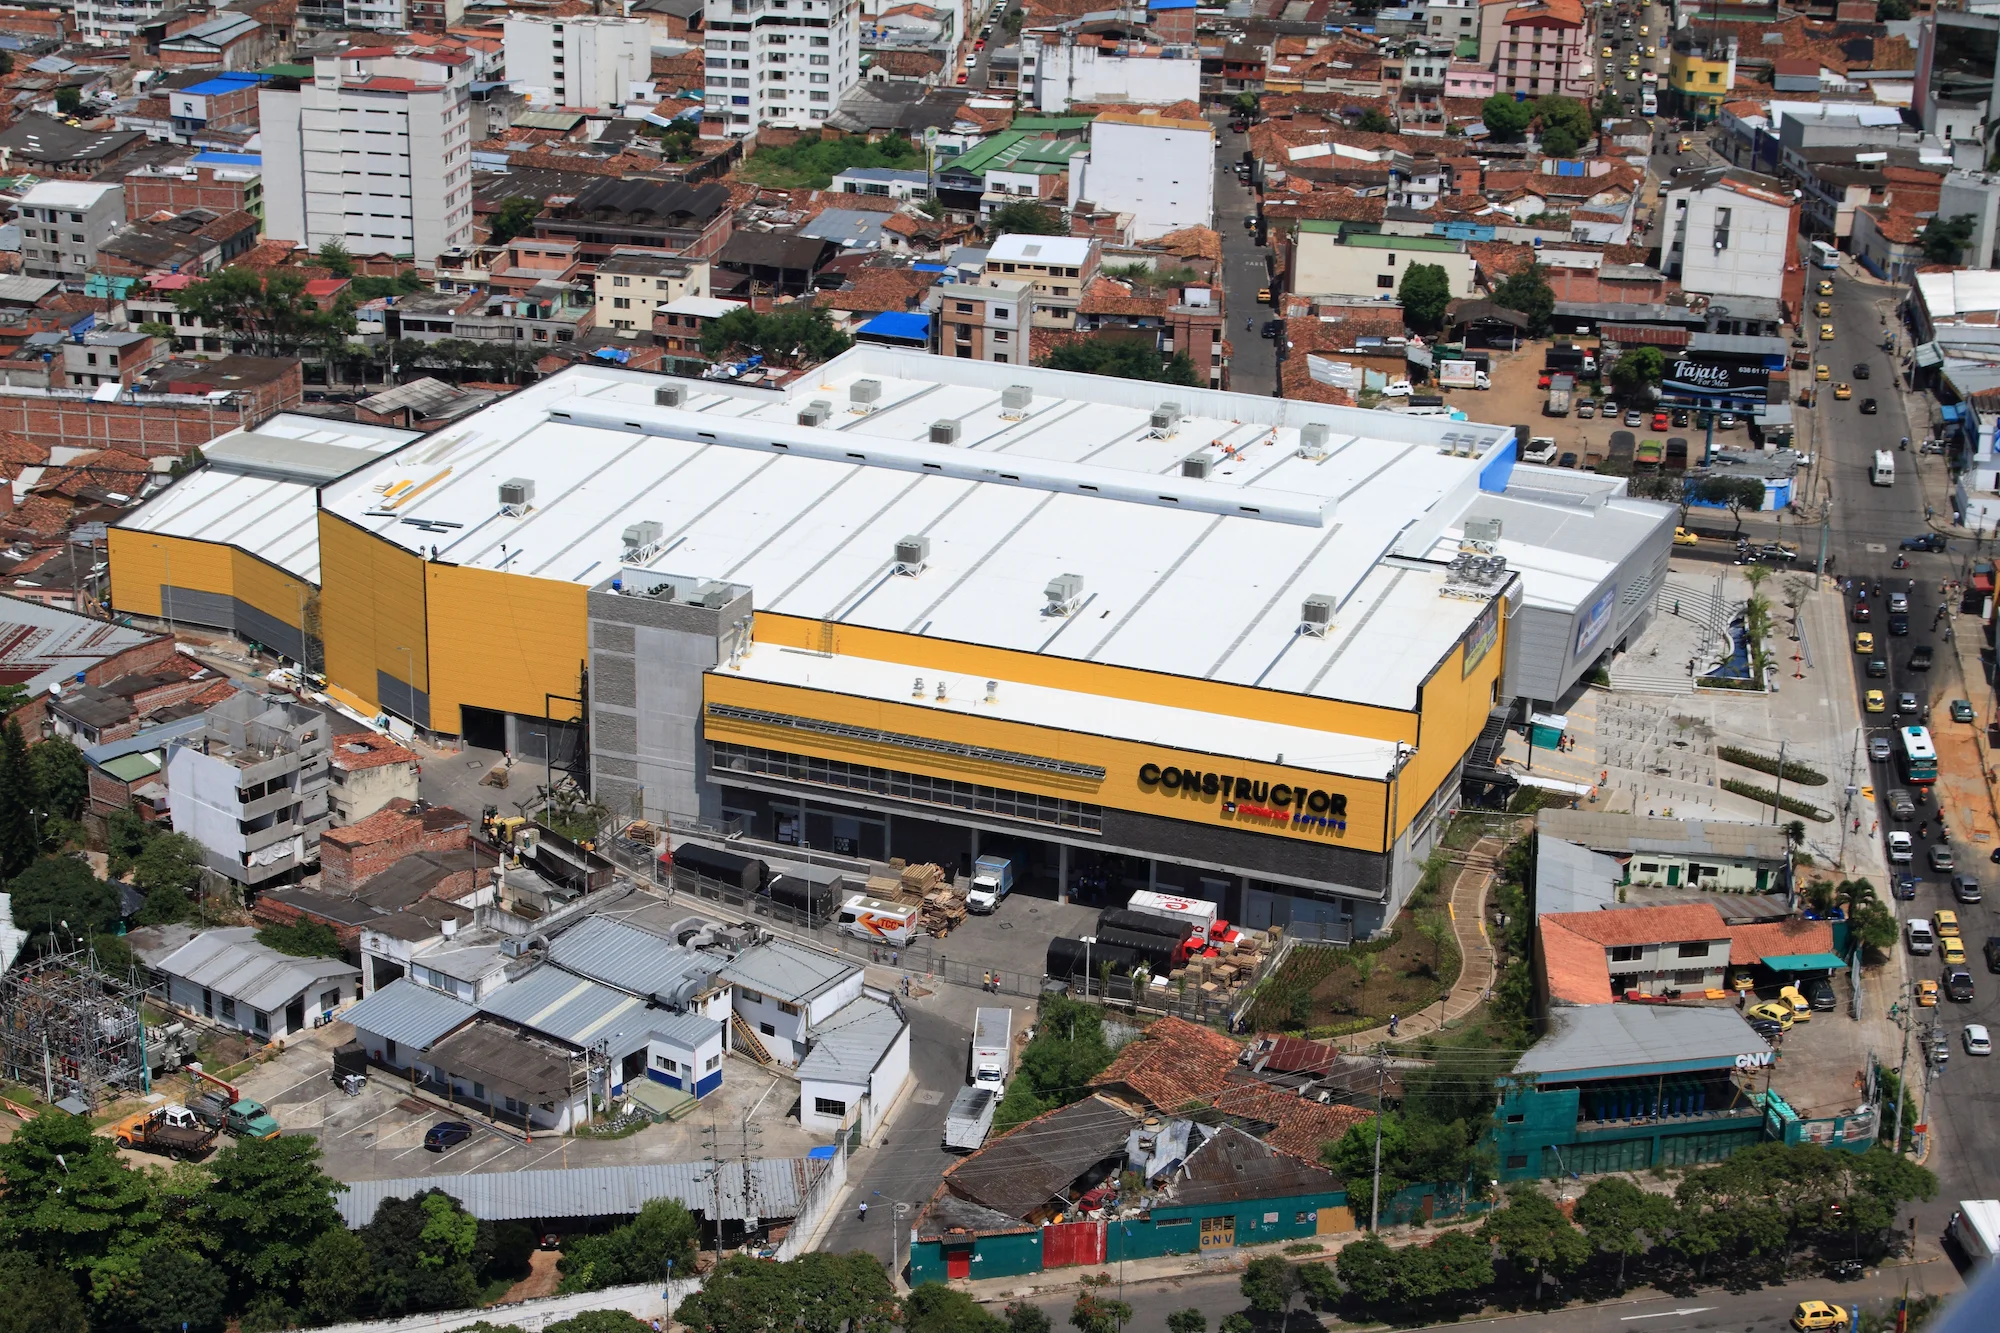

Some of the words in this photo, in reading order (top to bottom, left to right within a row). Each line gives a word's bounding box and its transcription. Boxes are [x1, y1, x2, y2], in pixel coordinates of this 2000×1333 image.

[1673, 360, 1728, 381] Fájate
[1697, 378, 1710, 386] For
[1139, 763, 1348, 817] CONSTRUCTOR
[880, 919, 897, 930] TCC
[1735, 1052, 1771, 1067] GNV
[1202, 1234, 1232, 1245] GNV
